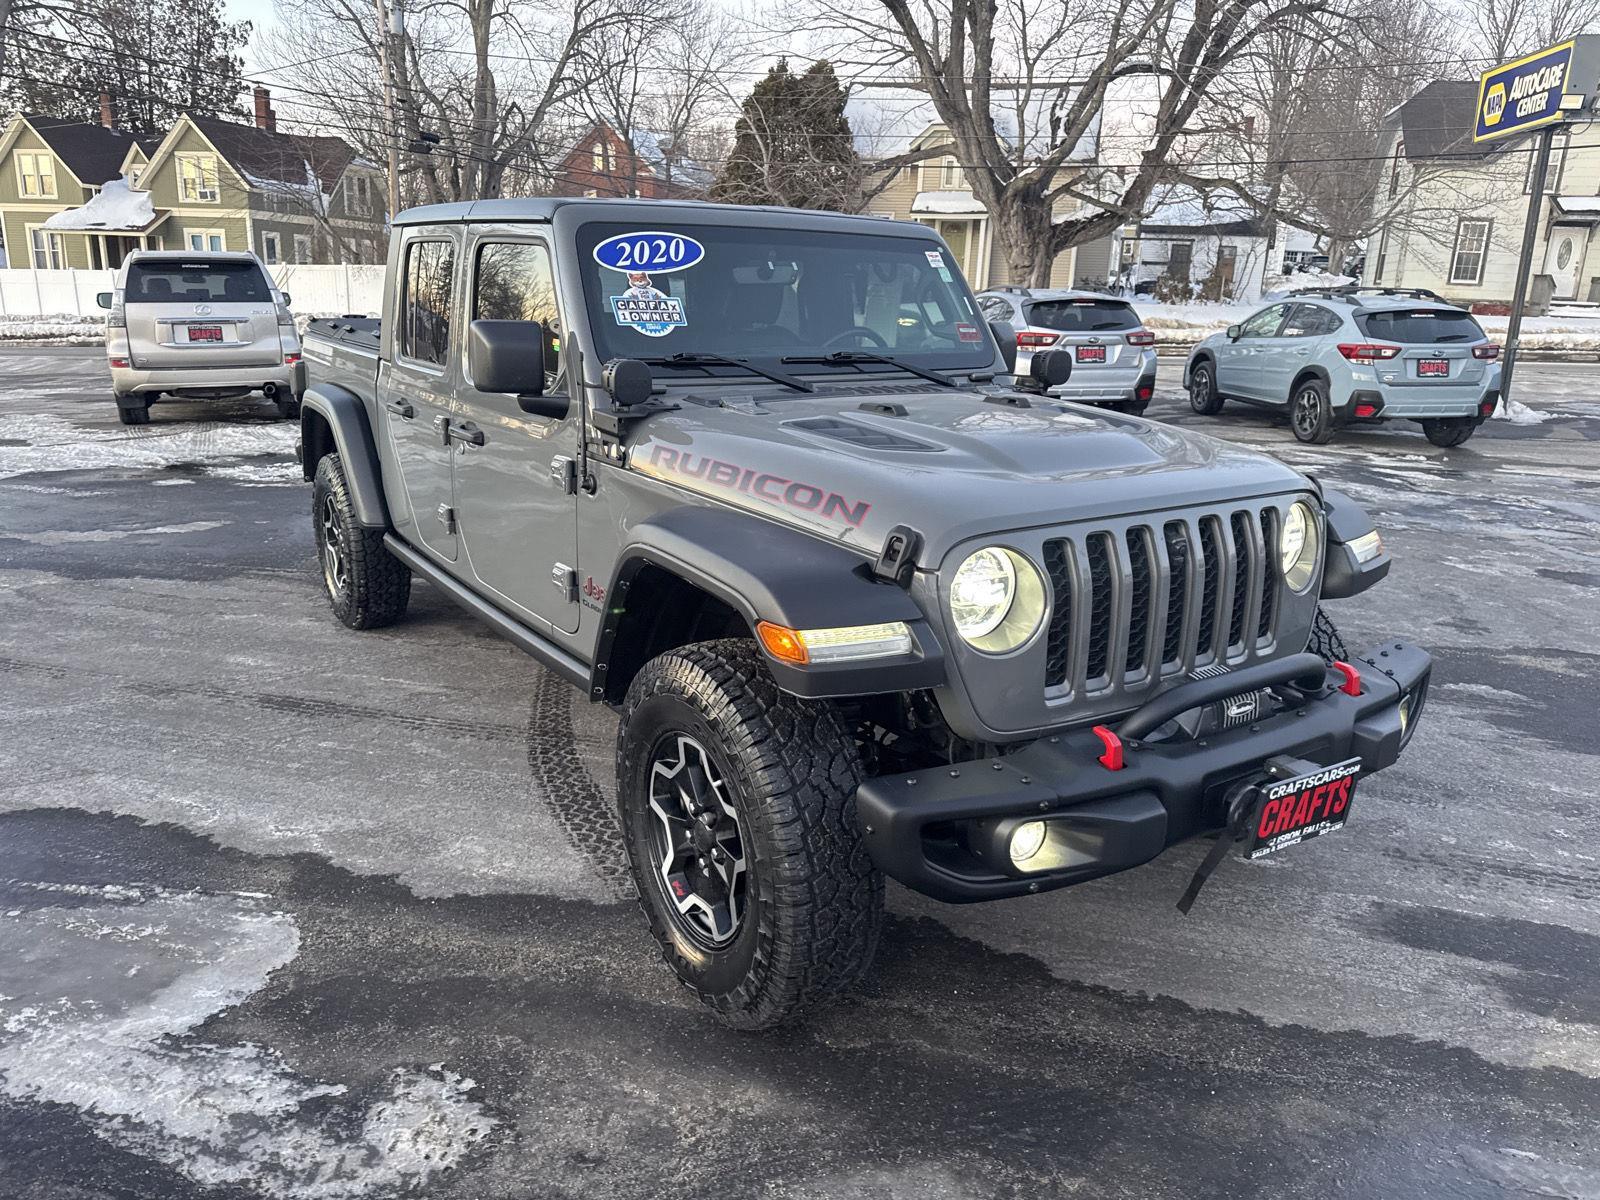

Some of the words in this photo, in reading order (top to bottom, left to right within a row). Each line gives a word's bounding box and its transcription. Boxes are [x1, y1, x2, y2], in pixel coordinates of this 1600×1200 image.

[1486, 93, 1503, 116] NAPA
[1516, 92, 1549, 118] CENTER
[616, 238, 685, 267] 2020
[617, 301, 678, 312] CARFAX
[621, 313, 628, 321] 1
[631, 313, 681, 321] OWNER
[190, 330, 221, 340] CRAFTS
[1078, 349, 1105, 359] CRAFTS
[1420, 363, 1447, 373] CRAFTS
[650, 444, 872, 528] RUBICON
[1257, 775, 1353, 838] CRAFTS
